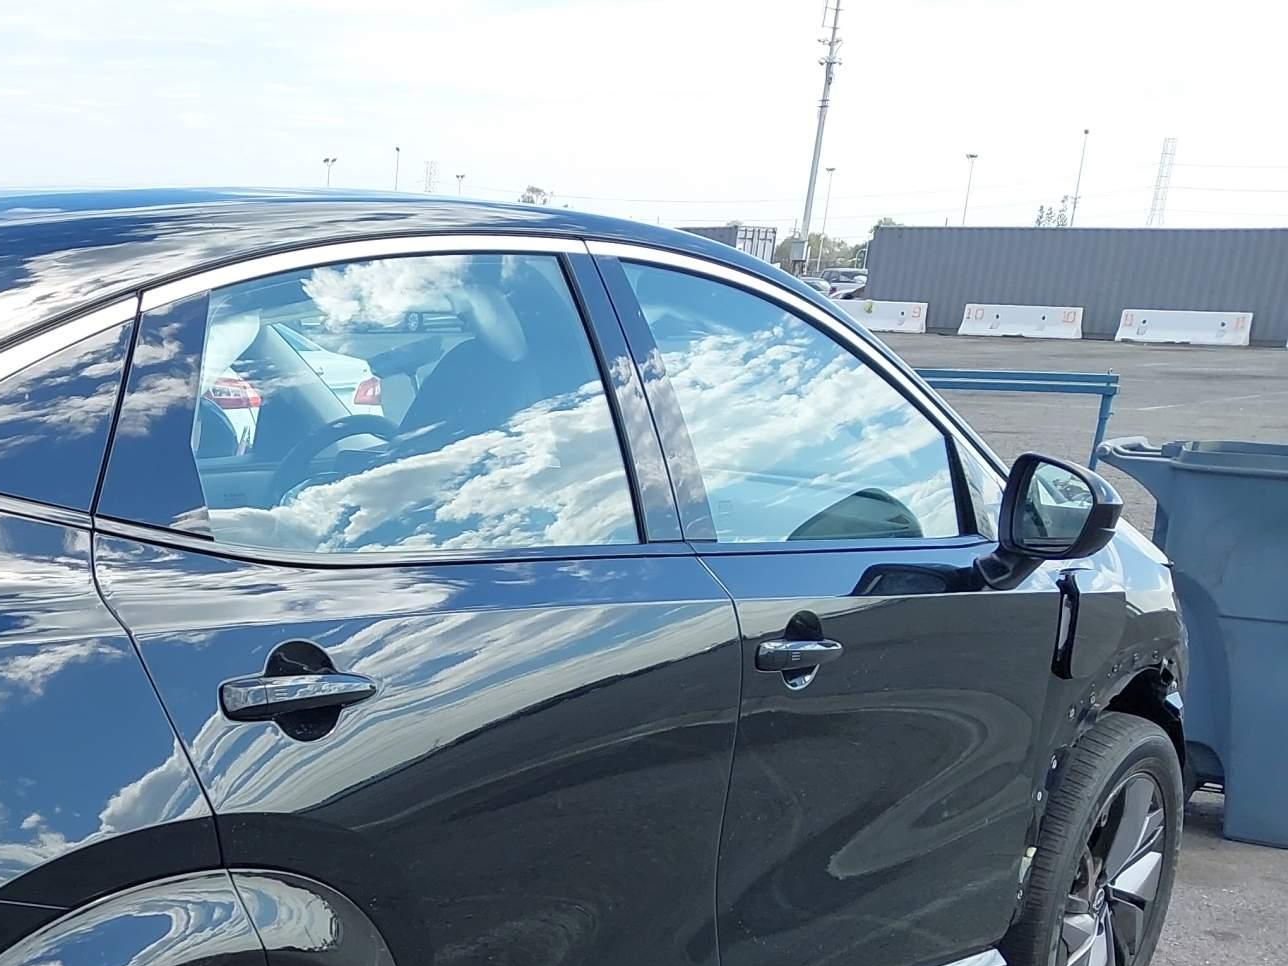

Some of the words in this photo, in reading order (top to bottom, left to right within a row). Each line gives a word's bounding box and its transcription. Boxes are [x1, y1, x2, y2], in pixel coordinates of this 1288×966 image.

[911, 306, 922, 319] 9
[965, 307, 985, 320] 10
[1062, 310, 1077, 324] 10
